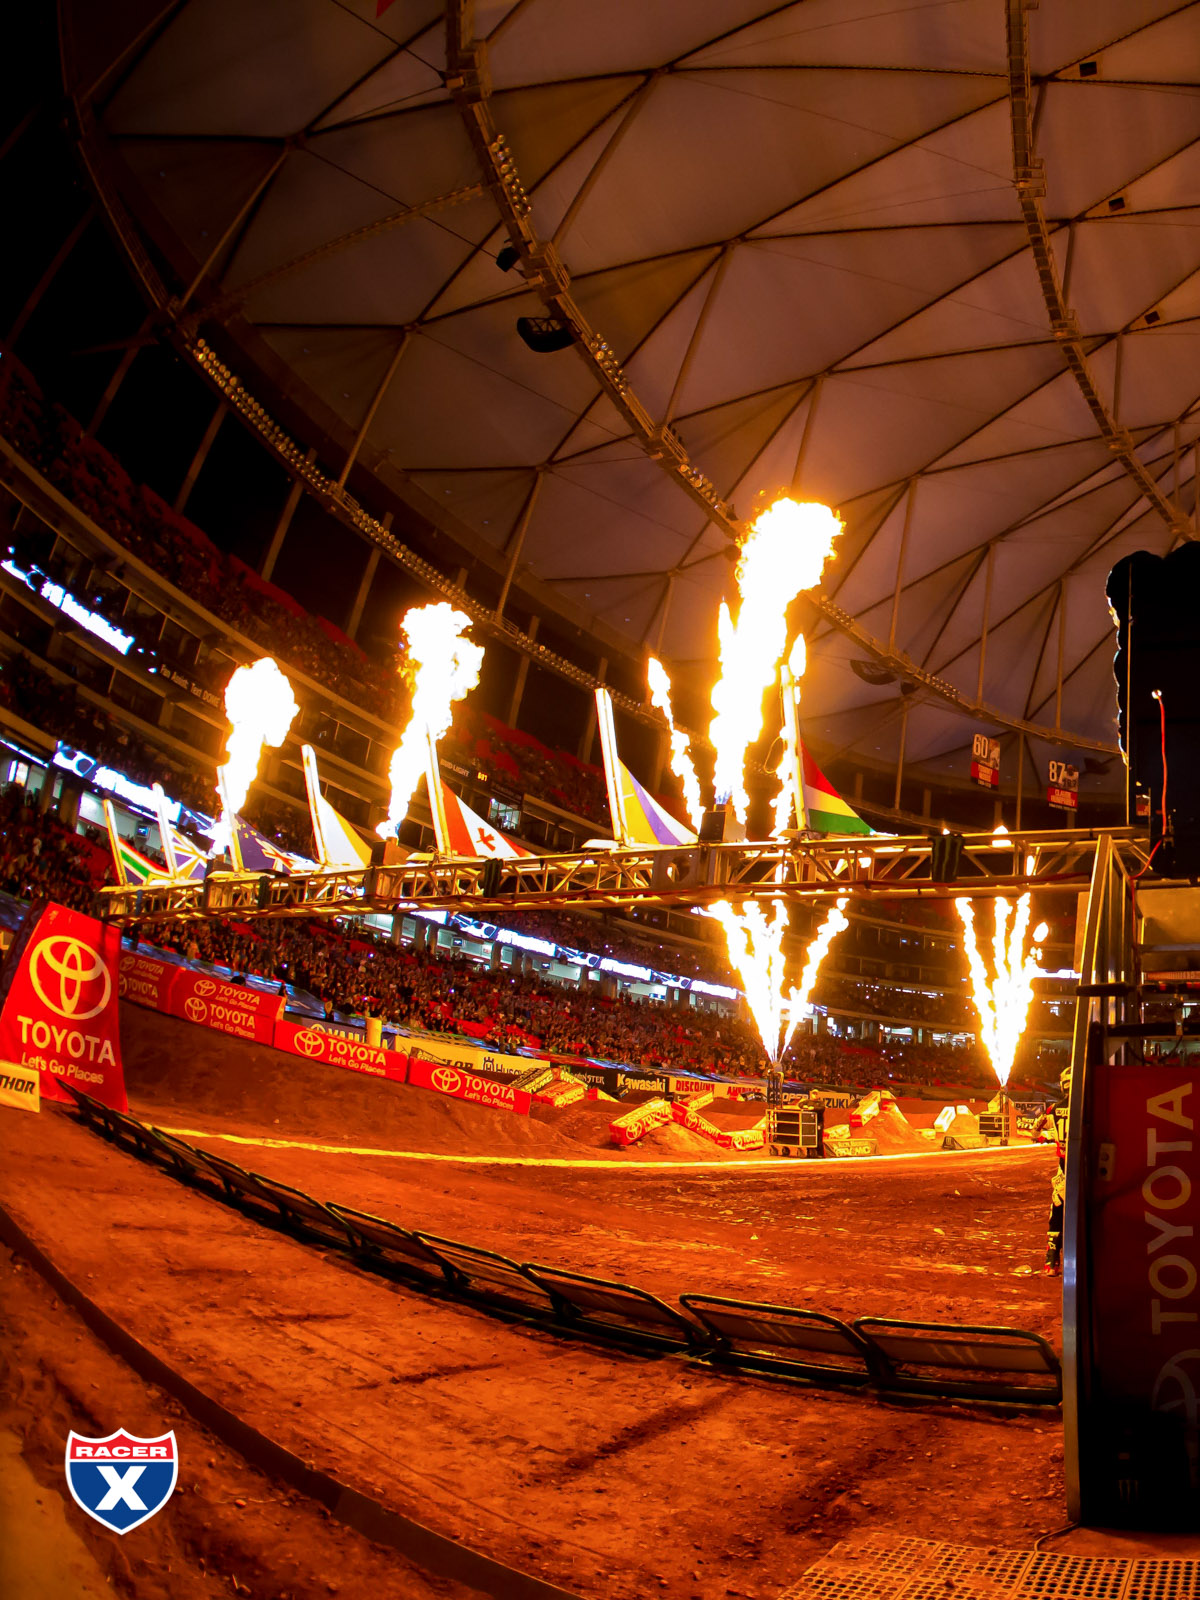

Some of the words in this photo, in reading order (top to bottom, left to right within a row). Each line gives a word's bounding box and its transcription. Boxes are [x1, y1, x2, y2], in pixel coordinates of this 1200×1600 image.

[973, 734, 989, 759] 60
[1049, 760, 1066, 785] 87
[218, 984, 260, 1006] TOYOTA
[210, 1003, 256, 1029] TOYOTA
[17, 1015, 116, 1067] TOYOTA
[328, 1038, 387, 1066] TOYOTA
[21, 1052, 47, 1072] Let's
[49, 1059, 66, 1076] Go
[67, 1064, 104, 1085] Places
[328, 1054, 347, 1066] Let's
[348, 1059, 360, 1069] Go
[360, 1062, 387, 1076] Places
[464, 1075, 516, 1101] TOYOTA
[617, 1073, 666, 1092] Kawasaki
[464, 1090, 481, 1101] Let's
[481, 1095, 491, 1104] Go
[492, 1098, 514, 1111] Places
[1141, 1081, 1198, 1335] TOYOTA
